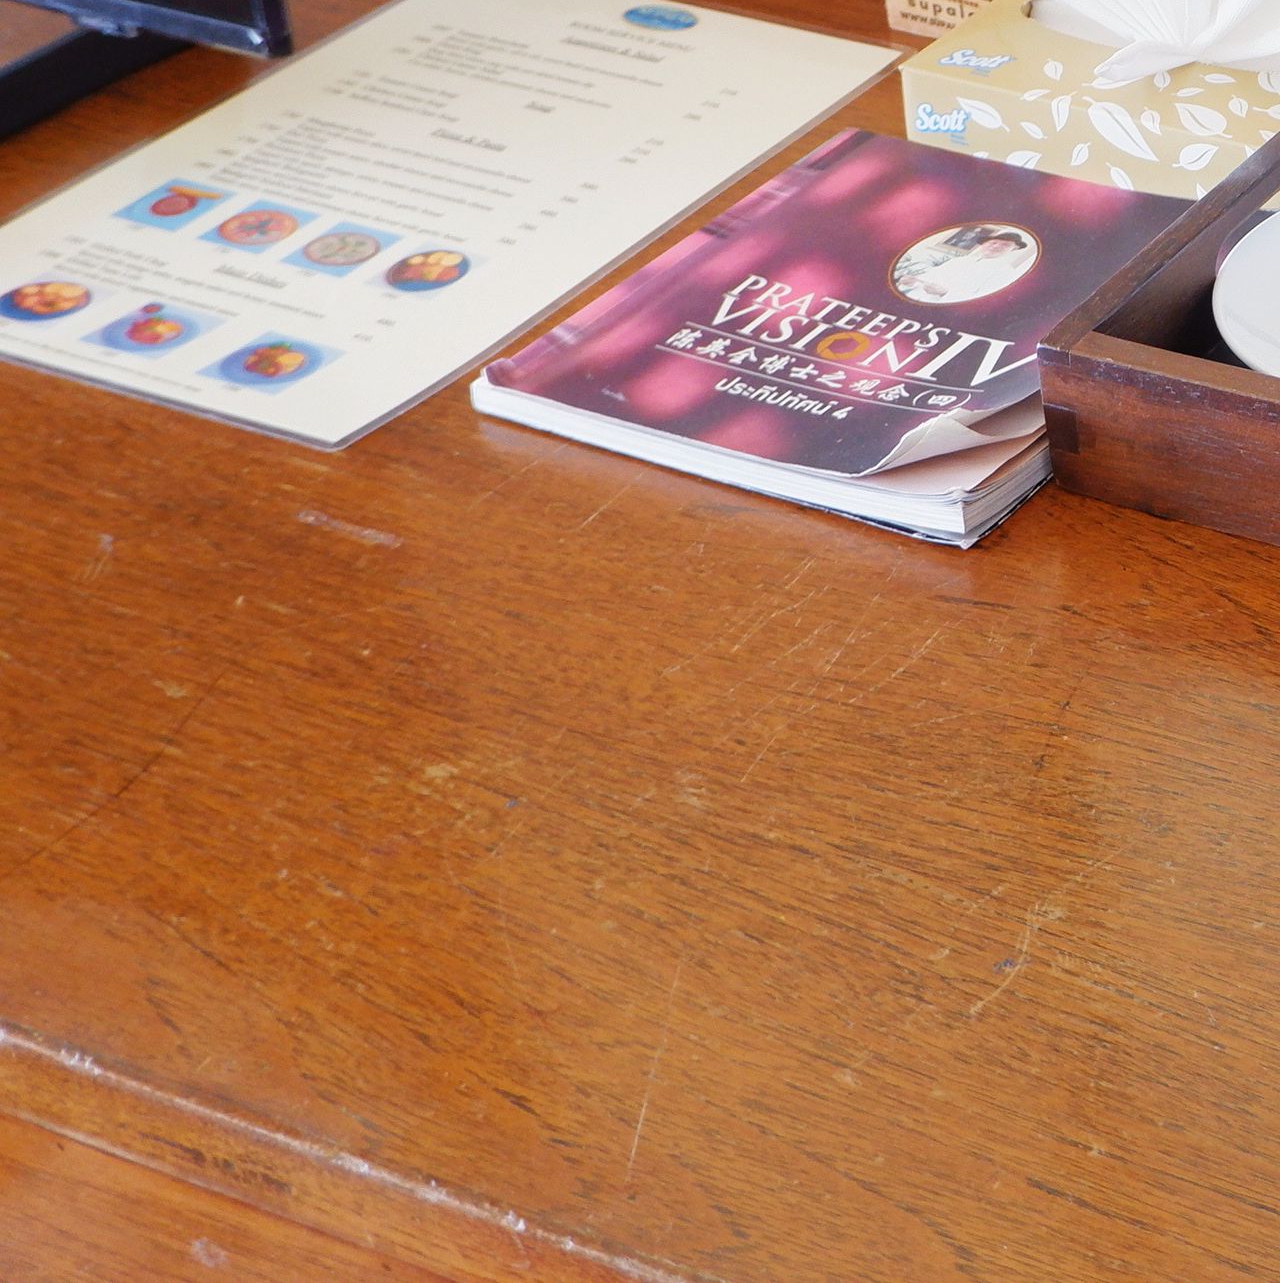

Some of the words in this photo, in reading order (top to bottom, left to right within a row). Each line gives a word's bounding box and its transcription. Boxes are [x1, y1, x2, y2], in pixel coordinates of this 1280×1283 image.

[939, 49, 1012, 68] Scott
[915, 103, 969, 133] Scott
[731, 274, 952, 350] PRATEEP'S
[710, 293, 931, 375] VISION
[904, 331, 1038, 387] IV
[714, 376, 840, 416] ประทีปทัศน์
[834, 407, 855, 420] 4
